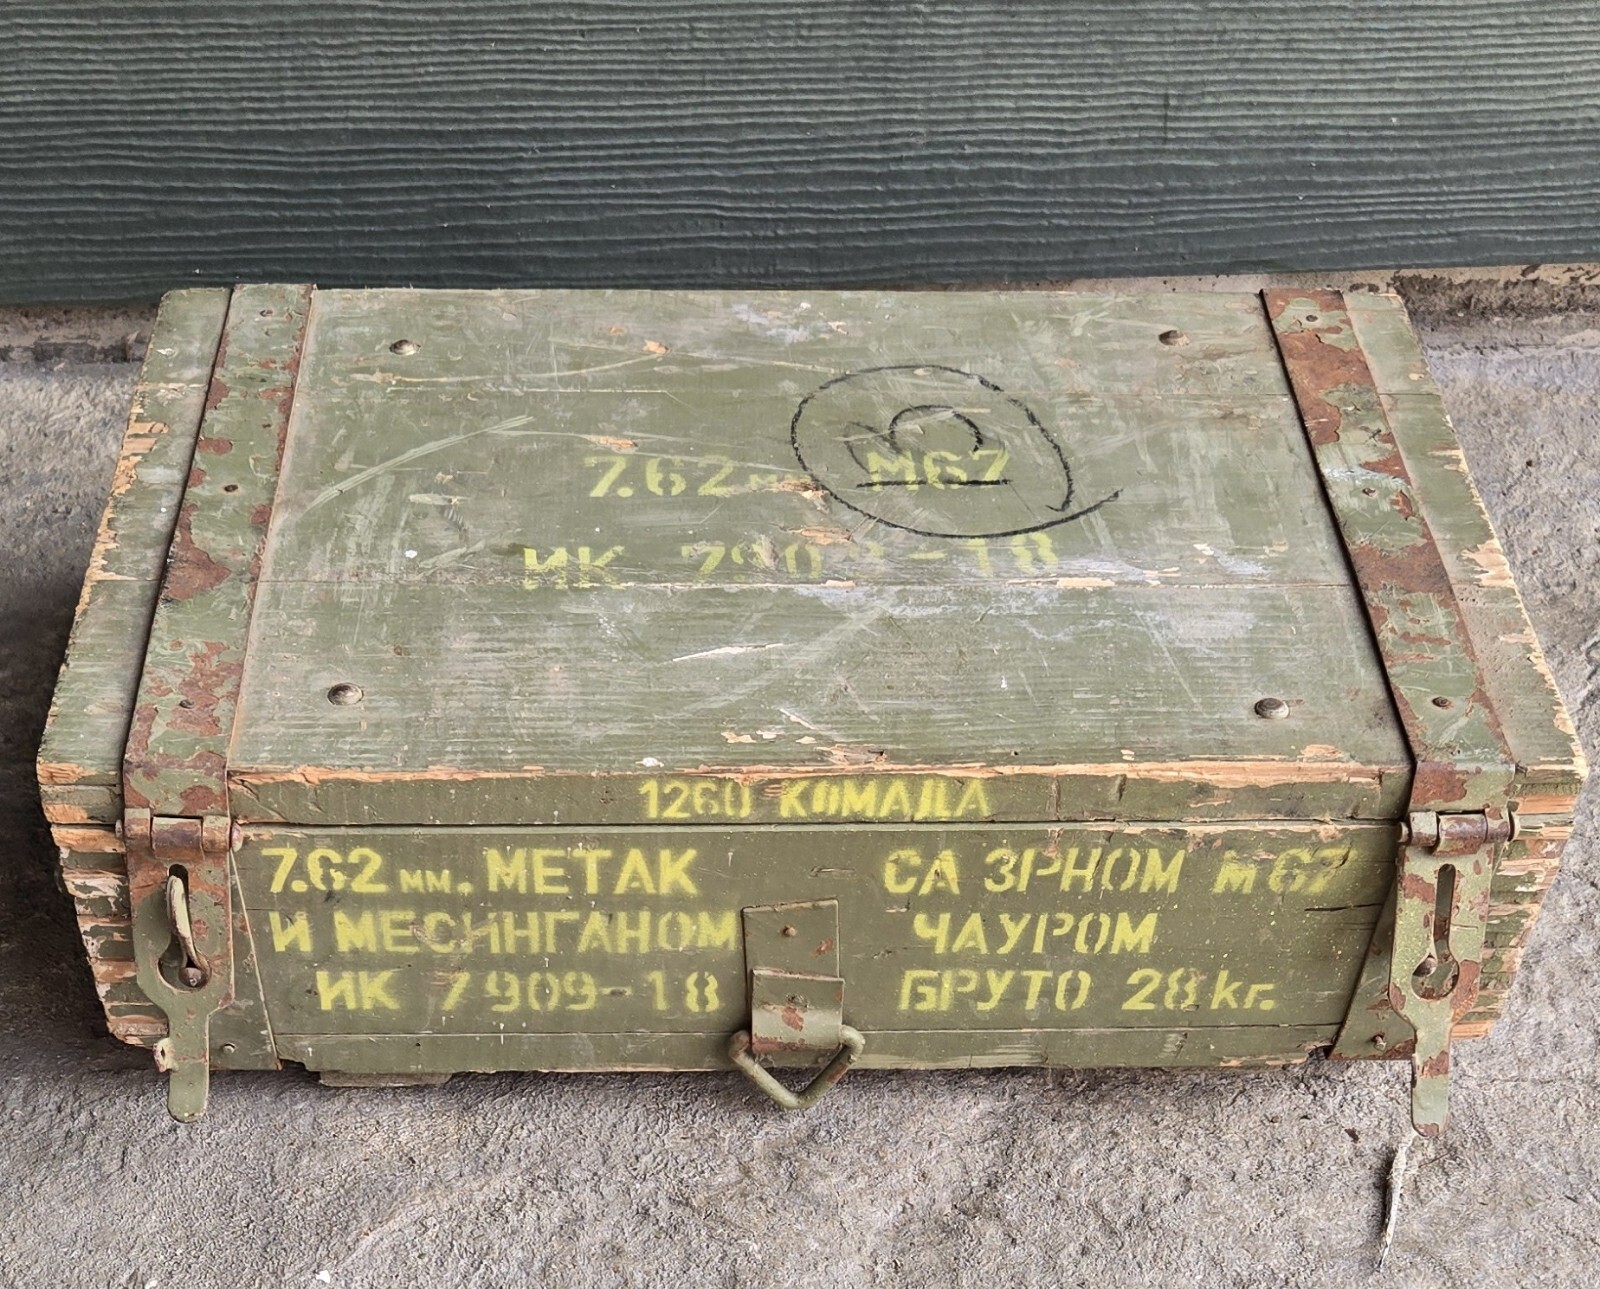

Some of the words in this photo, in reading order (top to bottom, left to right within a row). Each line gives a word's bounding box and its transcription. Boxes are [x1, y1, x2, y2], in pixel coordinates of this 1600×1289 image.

[584, 455, 734, 498] 7.62
[523, 545, 626, 590] ИК
[639, 779, 750, 819] 1260
[779, 778, 991, 820] КОМАДА
[262, 848, 387, 893] 7.62
[486, 849, 699, 894] МЕТАК
[884, 848, 960, 895] СА
[984, 848, 1186, 893] ЗРНОМ
[270, 911, 312, 952] И
[334, 910, 737, 953] МЕСИНГАНОМ
[913, 912, 1158, 954] ЧАУРОМ
[317, 970, 400, 1010] ИК
[899, 969, 1092, 1011] БРУТО
[1122, 968, 1200, 1011] 28
